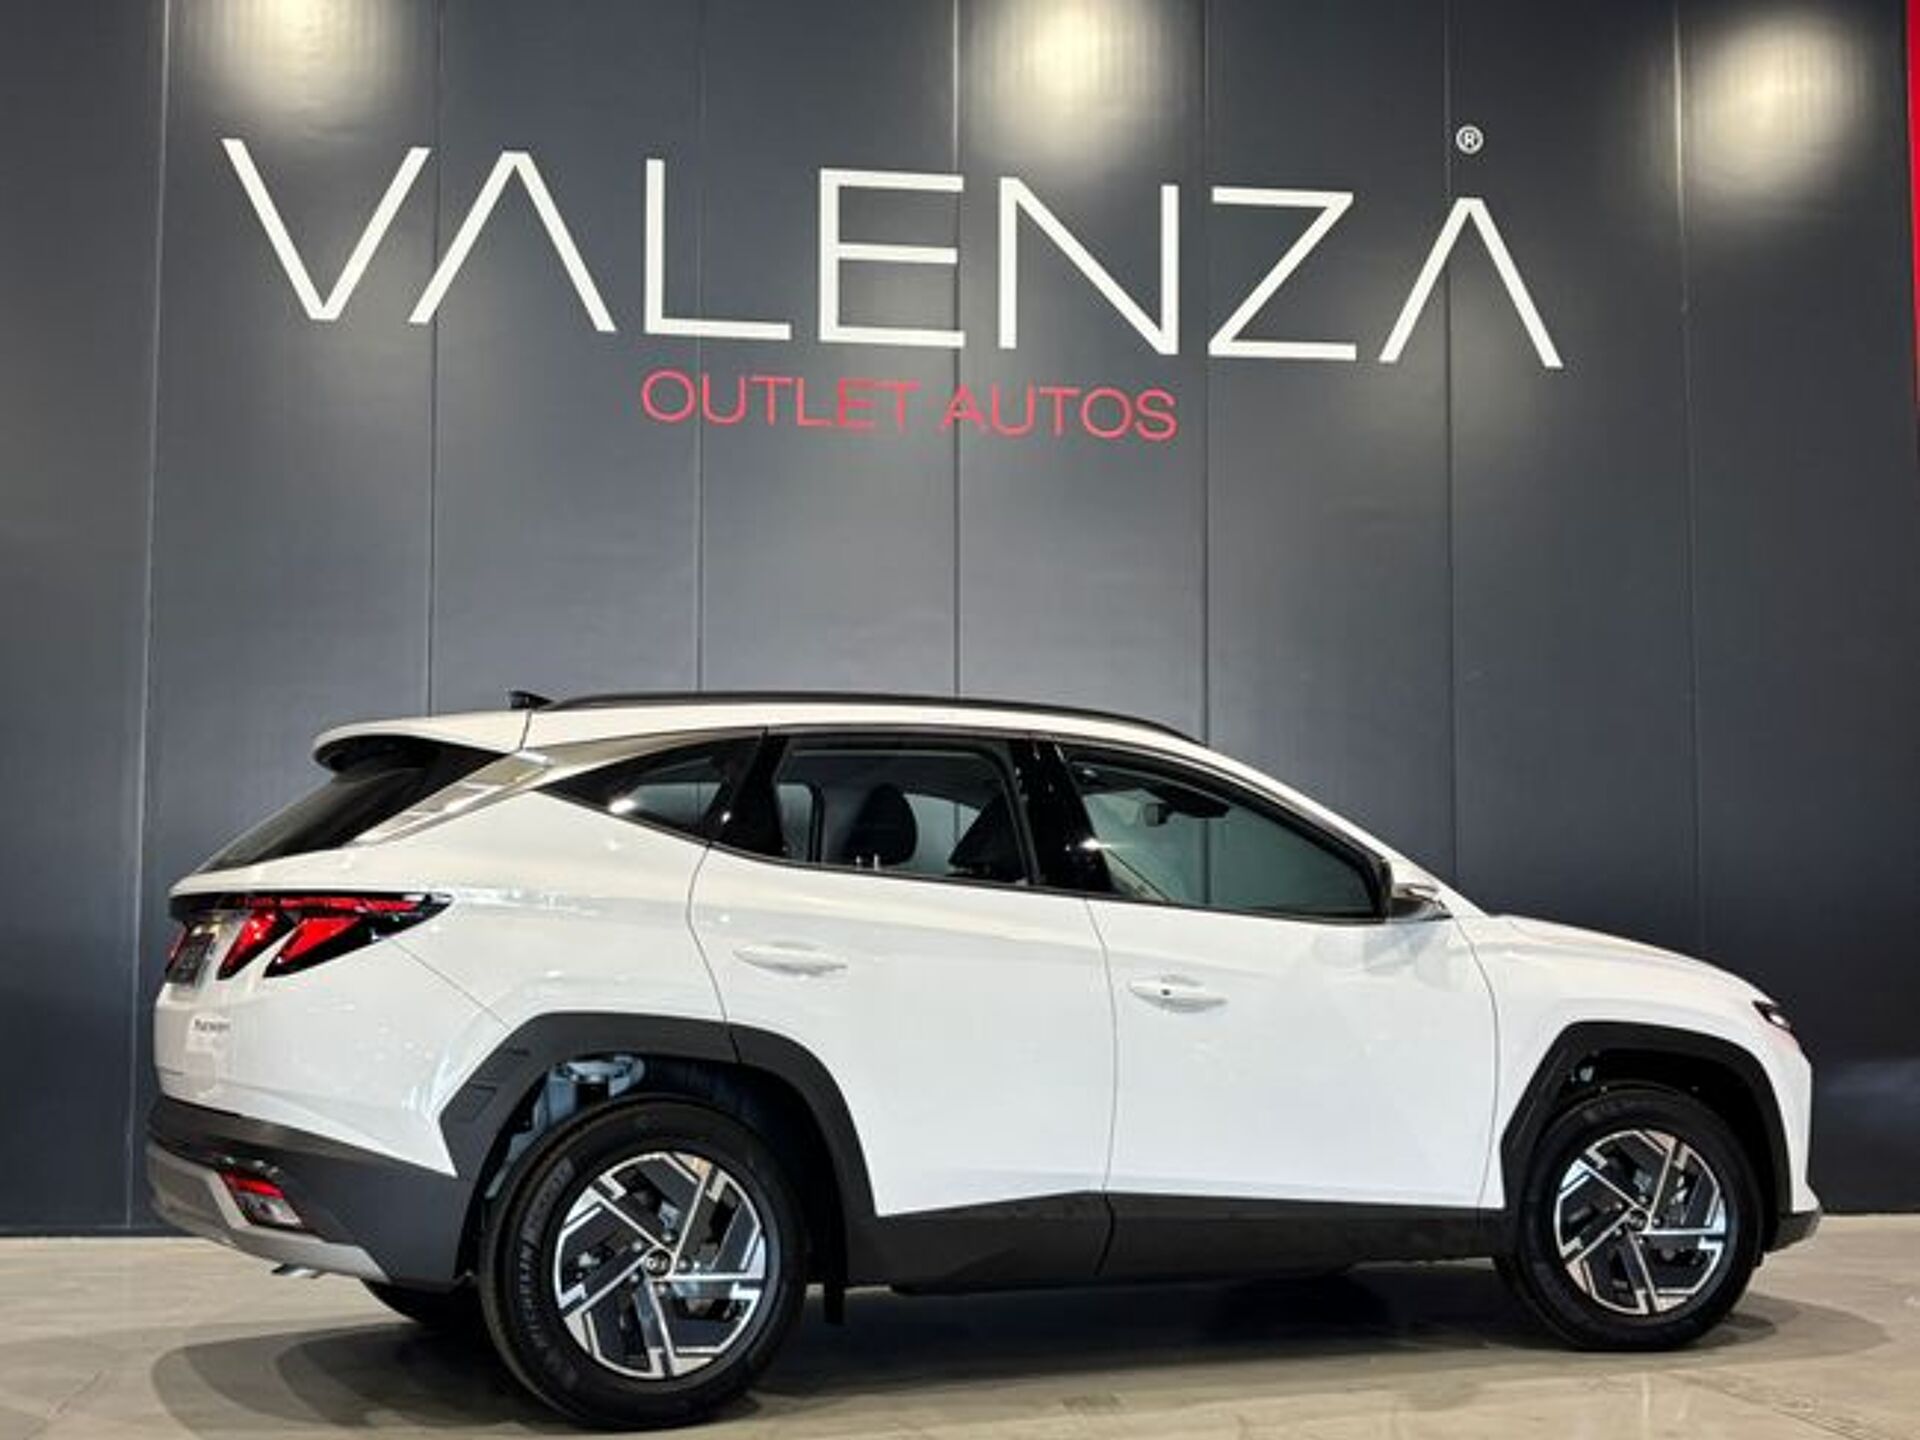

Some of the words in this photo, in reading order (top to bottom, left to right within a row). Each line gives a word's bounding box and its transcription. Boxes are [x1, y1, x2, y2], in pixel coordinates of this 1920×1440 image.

[221, 138, 1564, 369] VALENZA
[641, 370, 919, 433] OUTLET
[939, 382, 1178, 442] AUTOS
